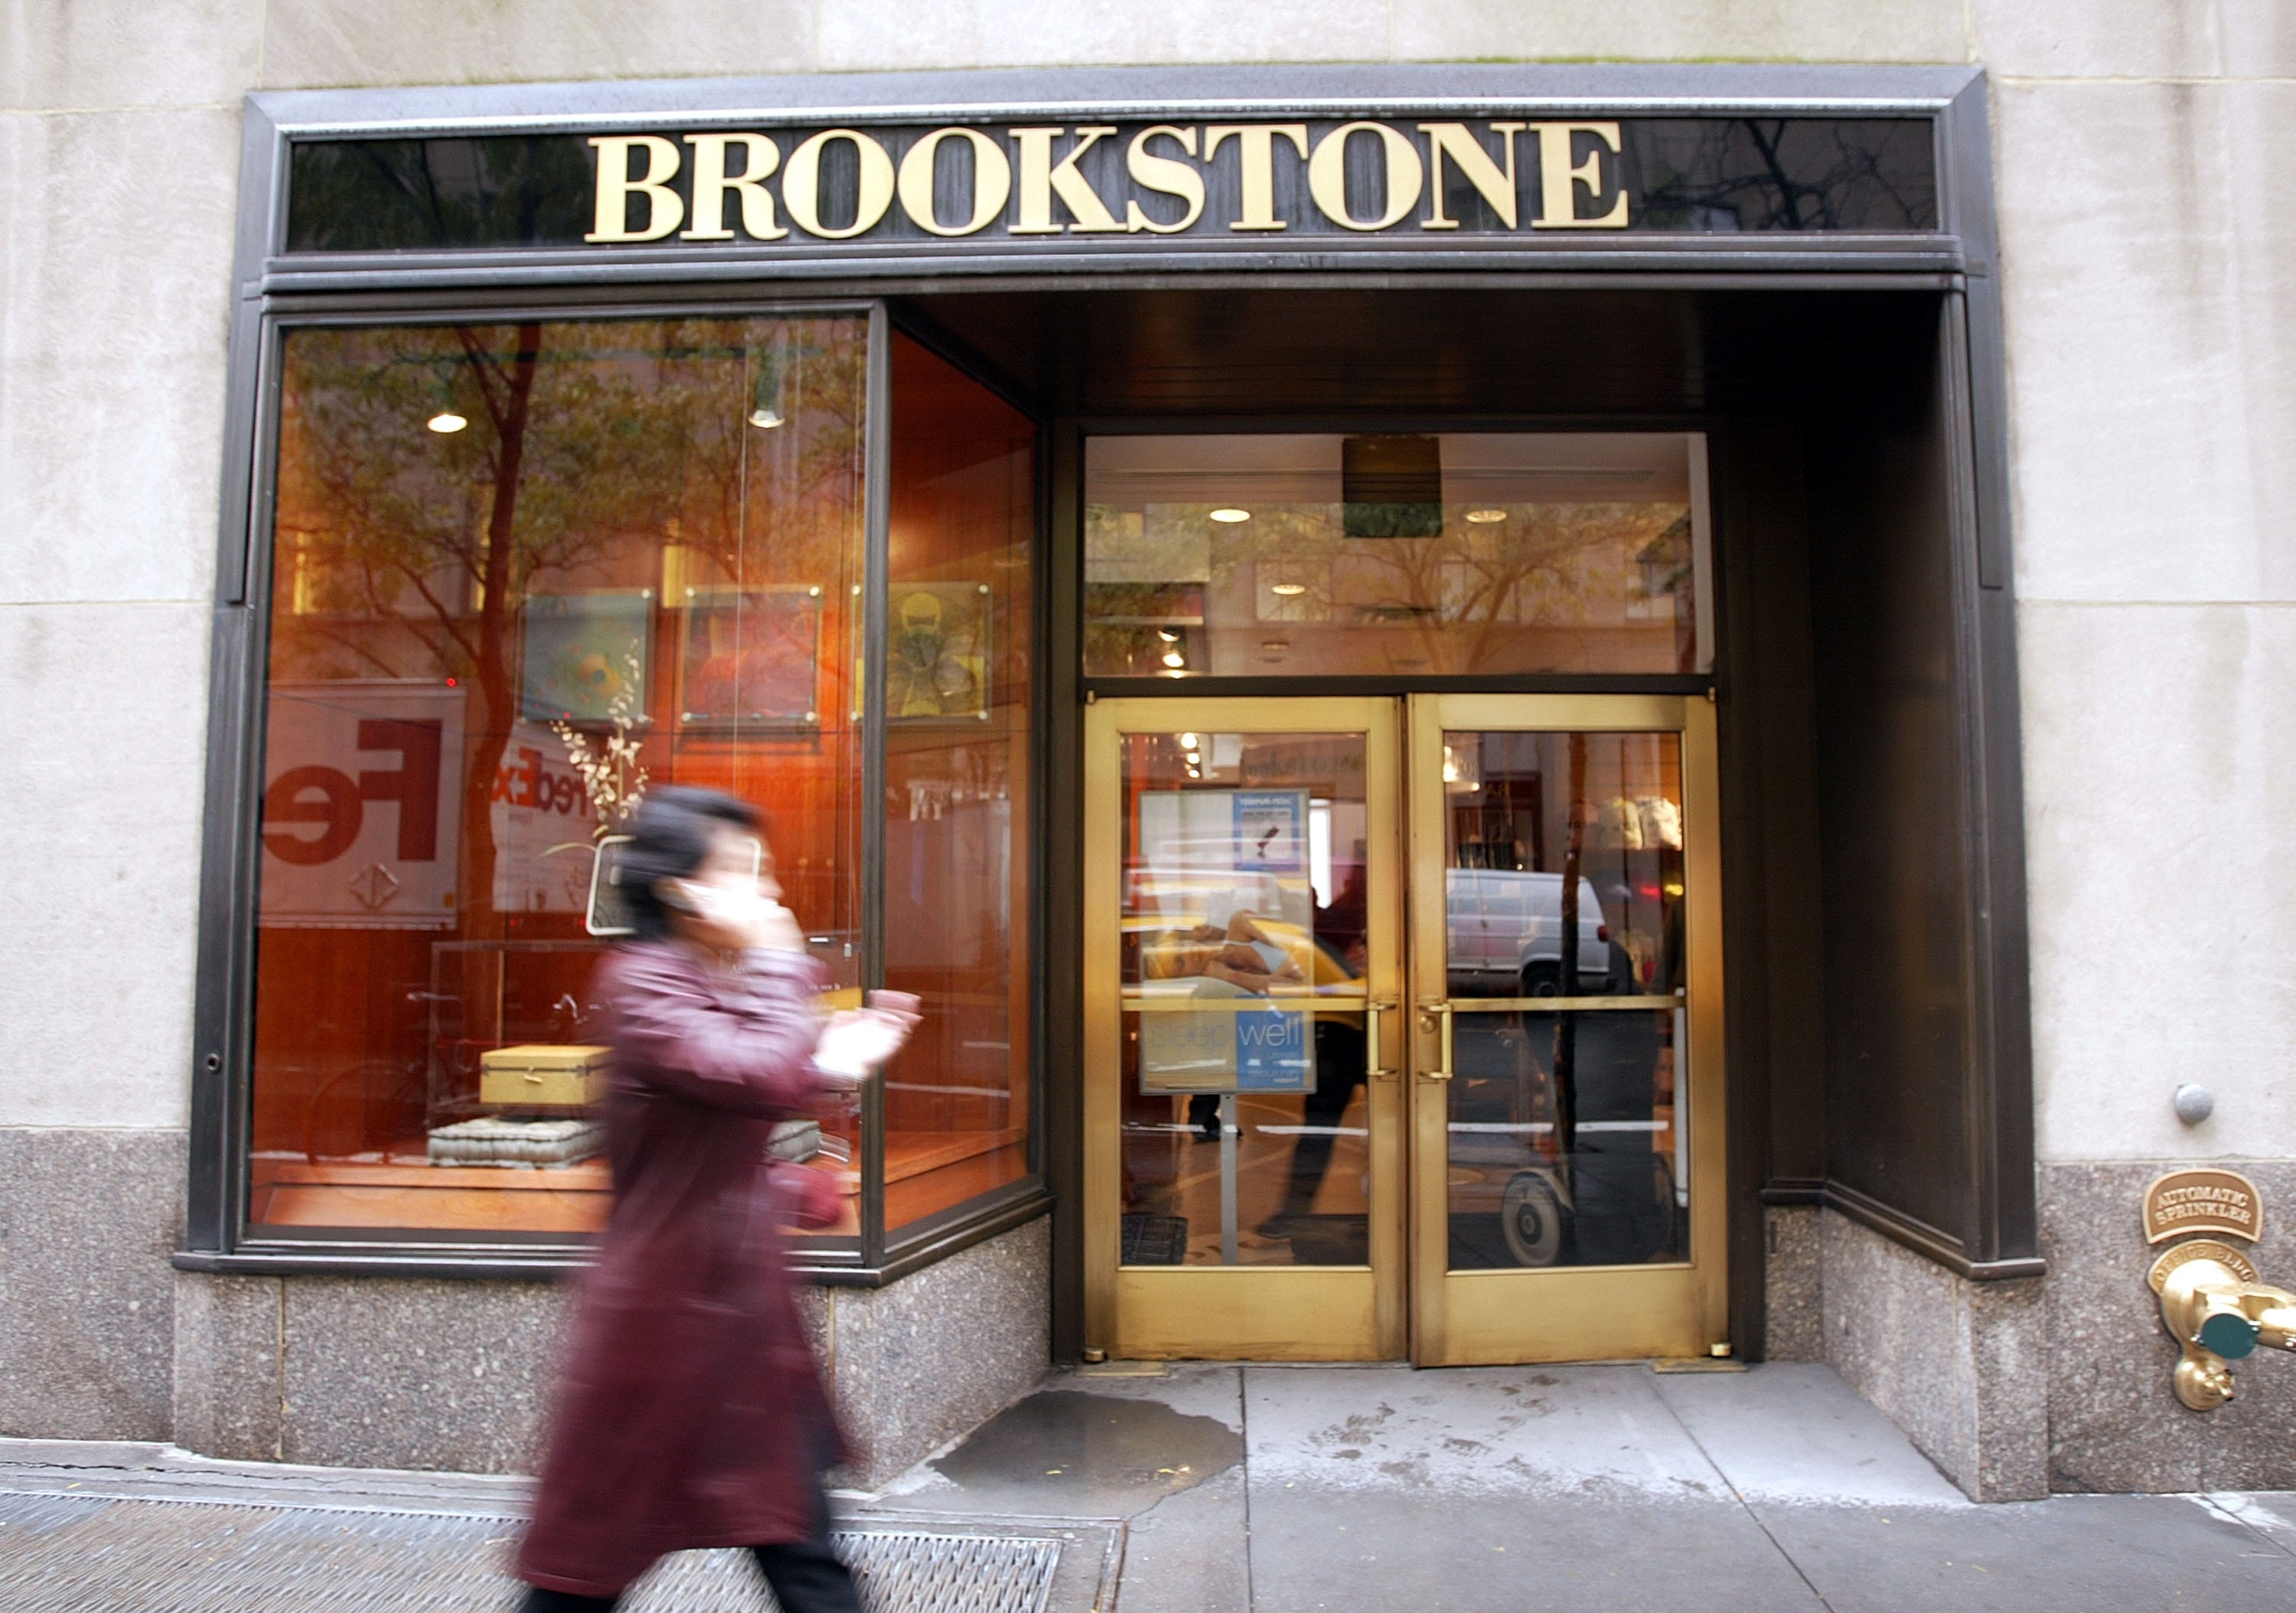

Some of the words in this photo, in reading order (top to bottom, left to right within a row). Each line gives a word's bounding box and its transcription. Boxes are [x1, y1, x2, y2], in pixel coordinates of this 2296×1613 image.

[585, 121, 1629, 243] BROOKSTONE
[1238, 1017, 1300, 1047] well
[2157, 1186, 2249, 1210] AUTOMATIC
[2154, 1201, 2252, 1225] SPRINKLER
